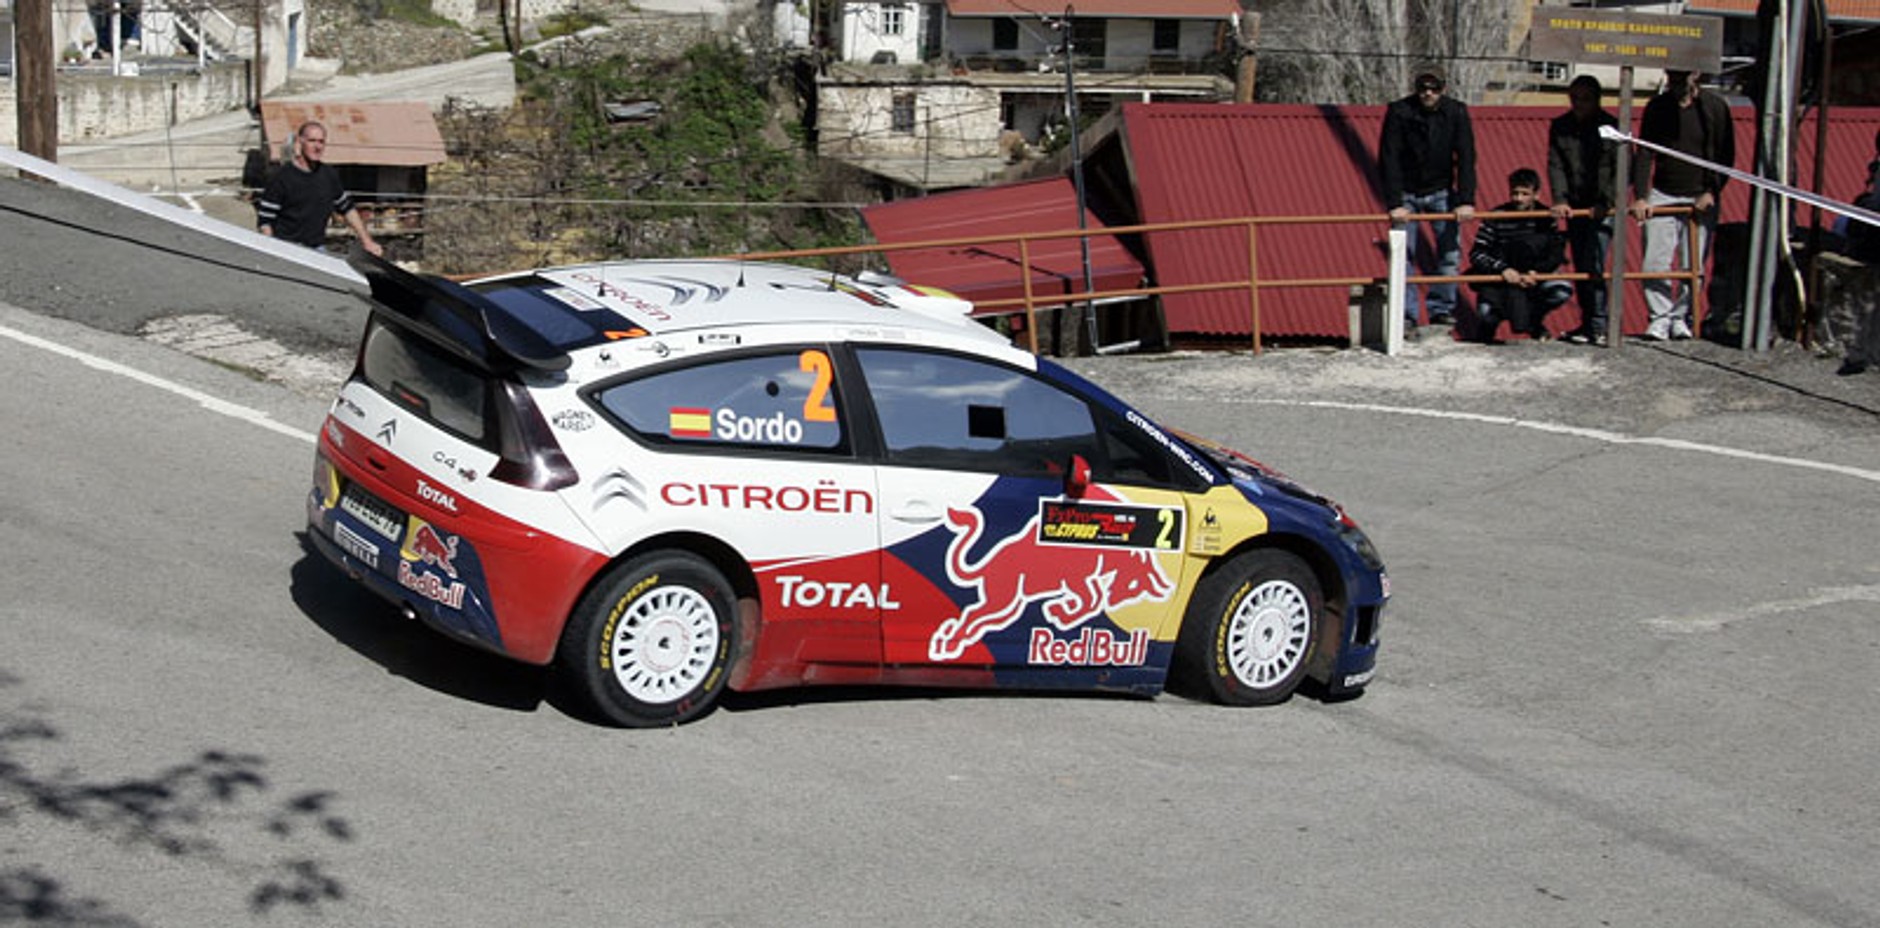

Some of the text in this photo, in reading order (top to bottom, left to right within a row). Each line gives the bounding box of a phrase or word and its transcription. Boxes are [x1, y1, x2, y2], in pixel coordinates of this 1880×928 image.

[799, 350, 837, 421] 2
[716, 408, 803, 443] Sordo
[416, 479, 459, 512] TOTAL
[1156, 508, 1175, 549] 2
[775, 576, 900, 610] TOTAL
